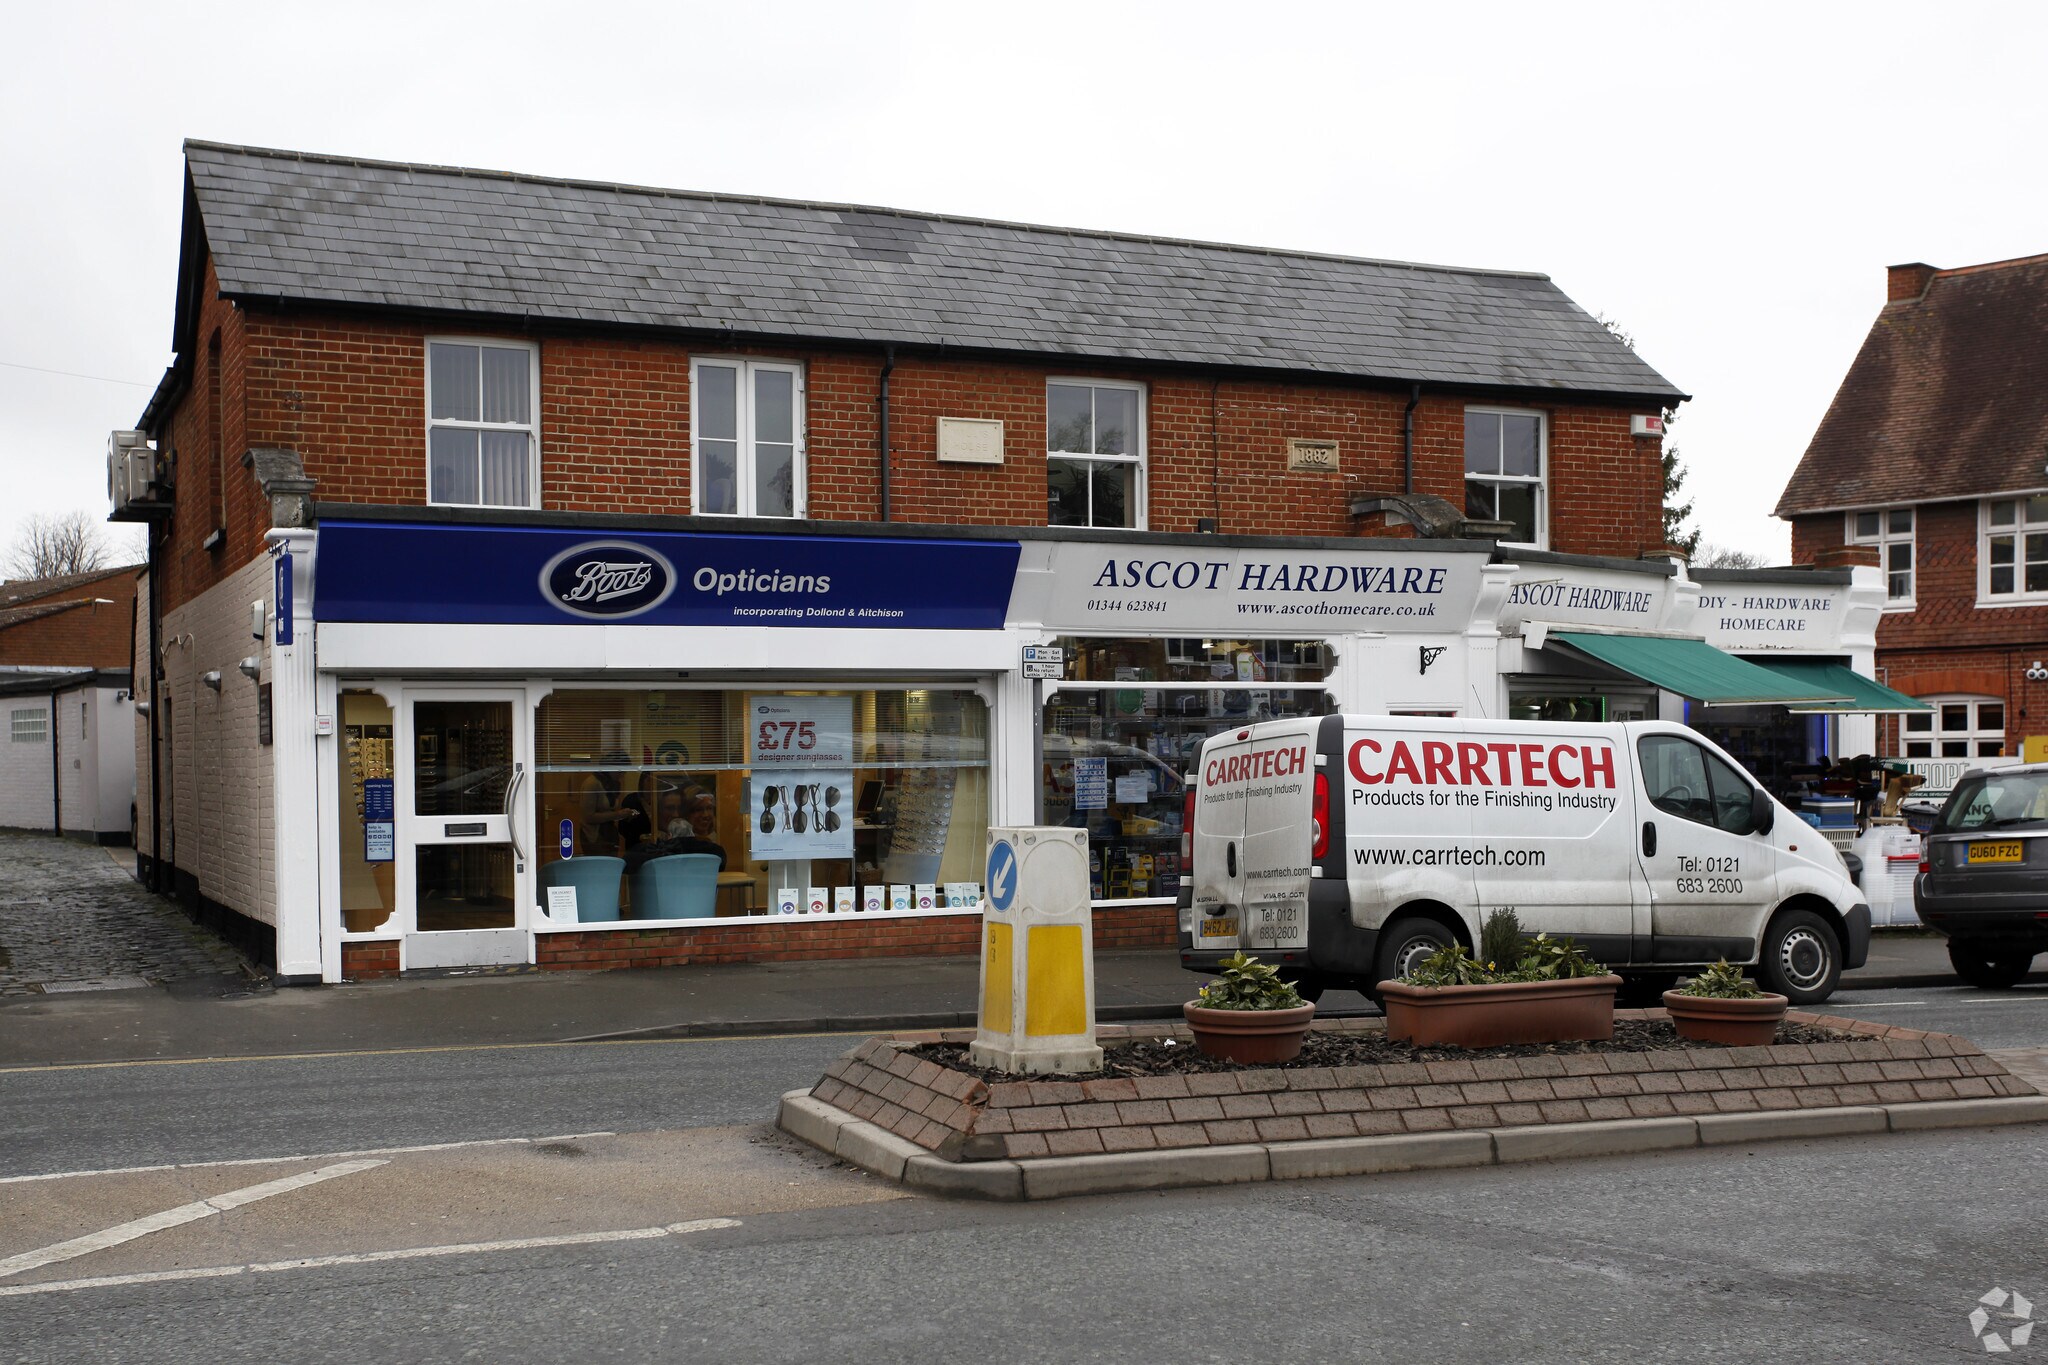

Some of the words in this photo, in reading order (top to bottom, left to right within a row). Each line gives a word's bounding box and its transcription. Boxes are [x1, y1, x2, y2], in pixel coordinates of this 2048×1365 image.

[1299, 448, 1328, 465] 1882
[561, 561, 652, 603] Boots
[693, 567, 831, 596] Opticians
[1093, 559, 1228, 590] ASCOT
[1237, 563, 1447, 595] HARDWARE
[1087, 600, 1122, 612] 01344
[1126, 600, 1167, 612] 623841
[1508, 583, 1567, 607] ASCOT
[1567, 586, 1652, 614] HARDWARE
[1698, 596, 1727, 609] DIY
[1743, 597, 1832, 611] HARDWARE
[734, 606, 803, 618] incorporating
[806, 607, 845, 617] Dollond
[848, 608, 856, 617] &
[858, 608, 904, 618] Aitchison
[1237, 601, 1436, 617] www.ascothomecare.co.uk
[1720, 617, 1806, 631] HOMECARE
[757, 720, 817, 750] £75
[758, 753, 795, 762] designer
[796, 753, 843, 762] sunglasses
[1348, 739, 1616, 789] CARRTECH
[1206, 746, 1306, 787] CARRTECH
[1204, 790, 1226, 804] Products
[1226, 789, 1234, 801] for
[1235, 788, 1244, 800] the
[1245, 786, 1273, 799] Finishing
[1275, 782, 1302, 796] Industry
[1352, 789, 1425, 806] Products
[1429, 789, 1450, 806] for
[1455, 790, 1479, 806] the
[1484, 790, 1552, 812] Finishing
[1558, 792, 1616, 812] Industry
[1354, 845, 1545, 866] www.carrtech.com
[1970, 846, 1996, 859] GU60
[1999, 845, 2019, 858] FZC
[1246, 866, 1310, 880] www.carrtech.com
[1677, 856, 1702, 872] Tel:
[1706, 856, 1739, 873] 0121
[1677, 878, 1704, 893] 683
[1708, 878, 1743, 894] 2600
[1261, 909, 1275, 922] Tel:
[1277, 908, 1297, 921] 0121
[1260, 926, 1275, 940] 683
[1277, 925, 1298, 940] 2600
